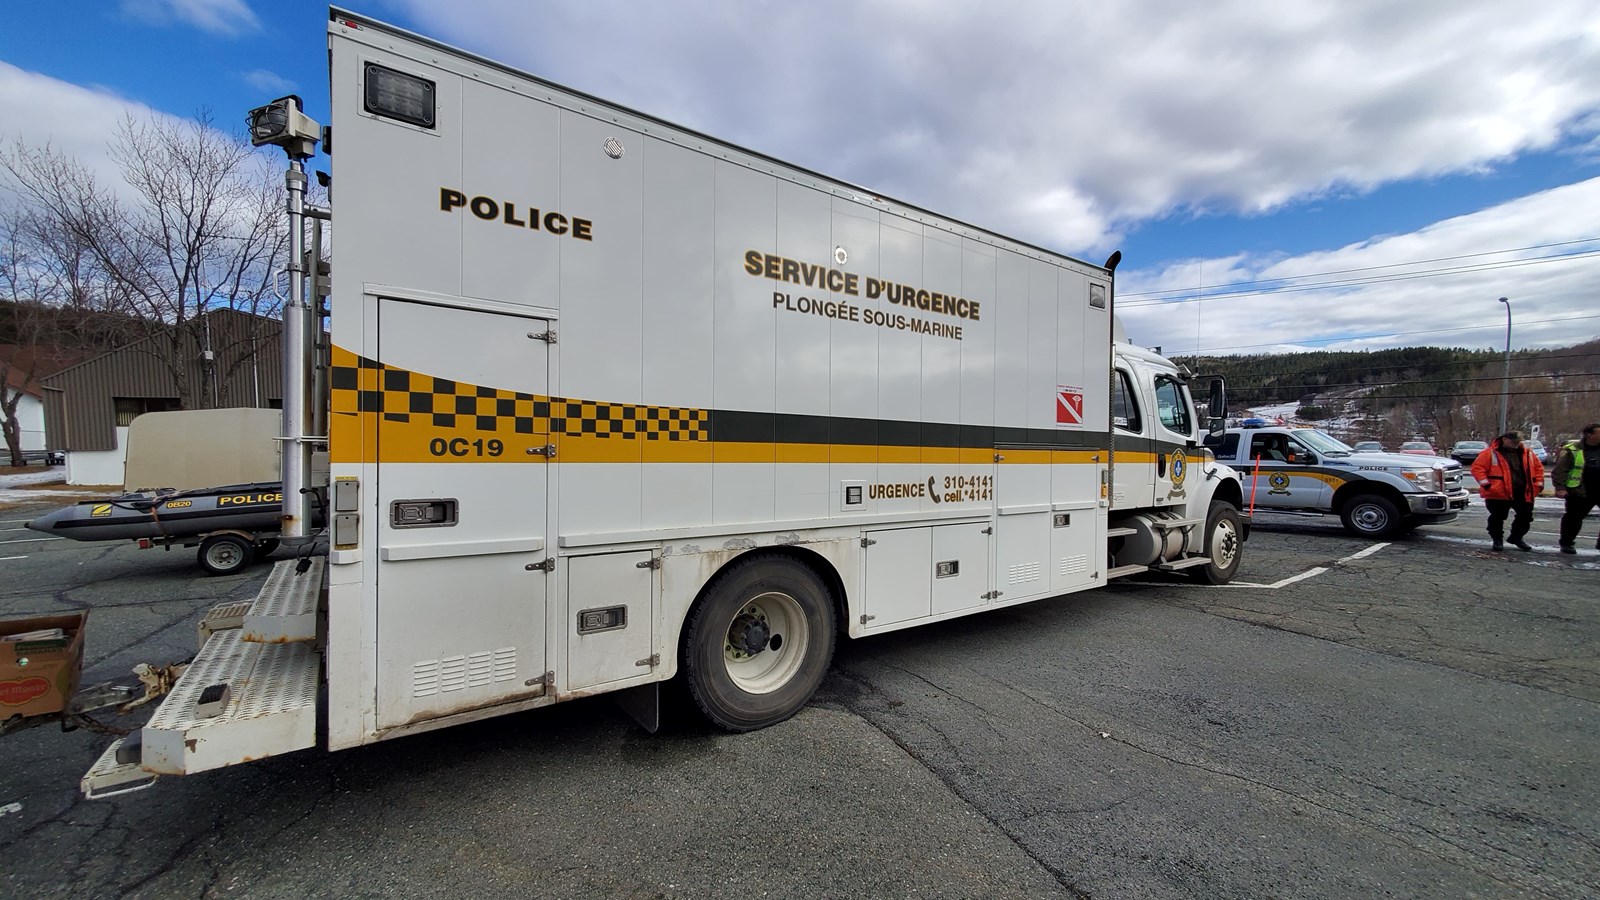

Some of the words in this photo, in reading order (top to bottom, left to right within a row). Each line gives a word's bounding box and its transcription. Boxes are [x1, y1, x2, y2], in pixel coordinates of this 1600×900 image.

[440, 186, 593, 241] POLICE
[743, 249, 860, 297] SERVICE
[865, 275, 981, 322] D'URGENCE
[772, 291, 860, 323] PLONGÉE
[863, 308, 963, 341] SOUS-MARINE
[869, 483, 925, 499] URGENCE
[944, 475, 993, 489] 310-4141
[220, 493, 282, 505] POLICE
